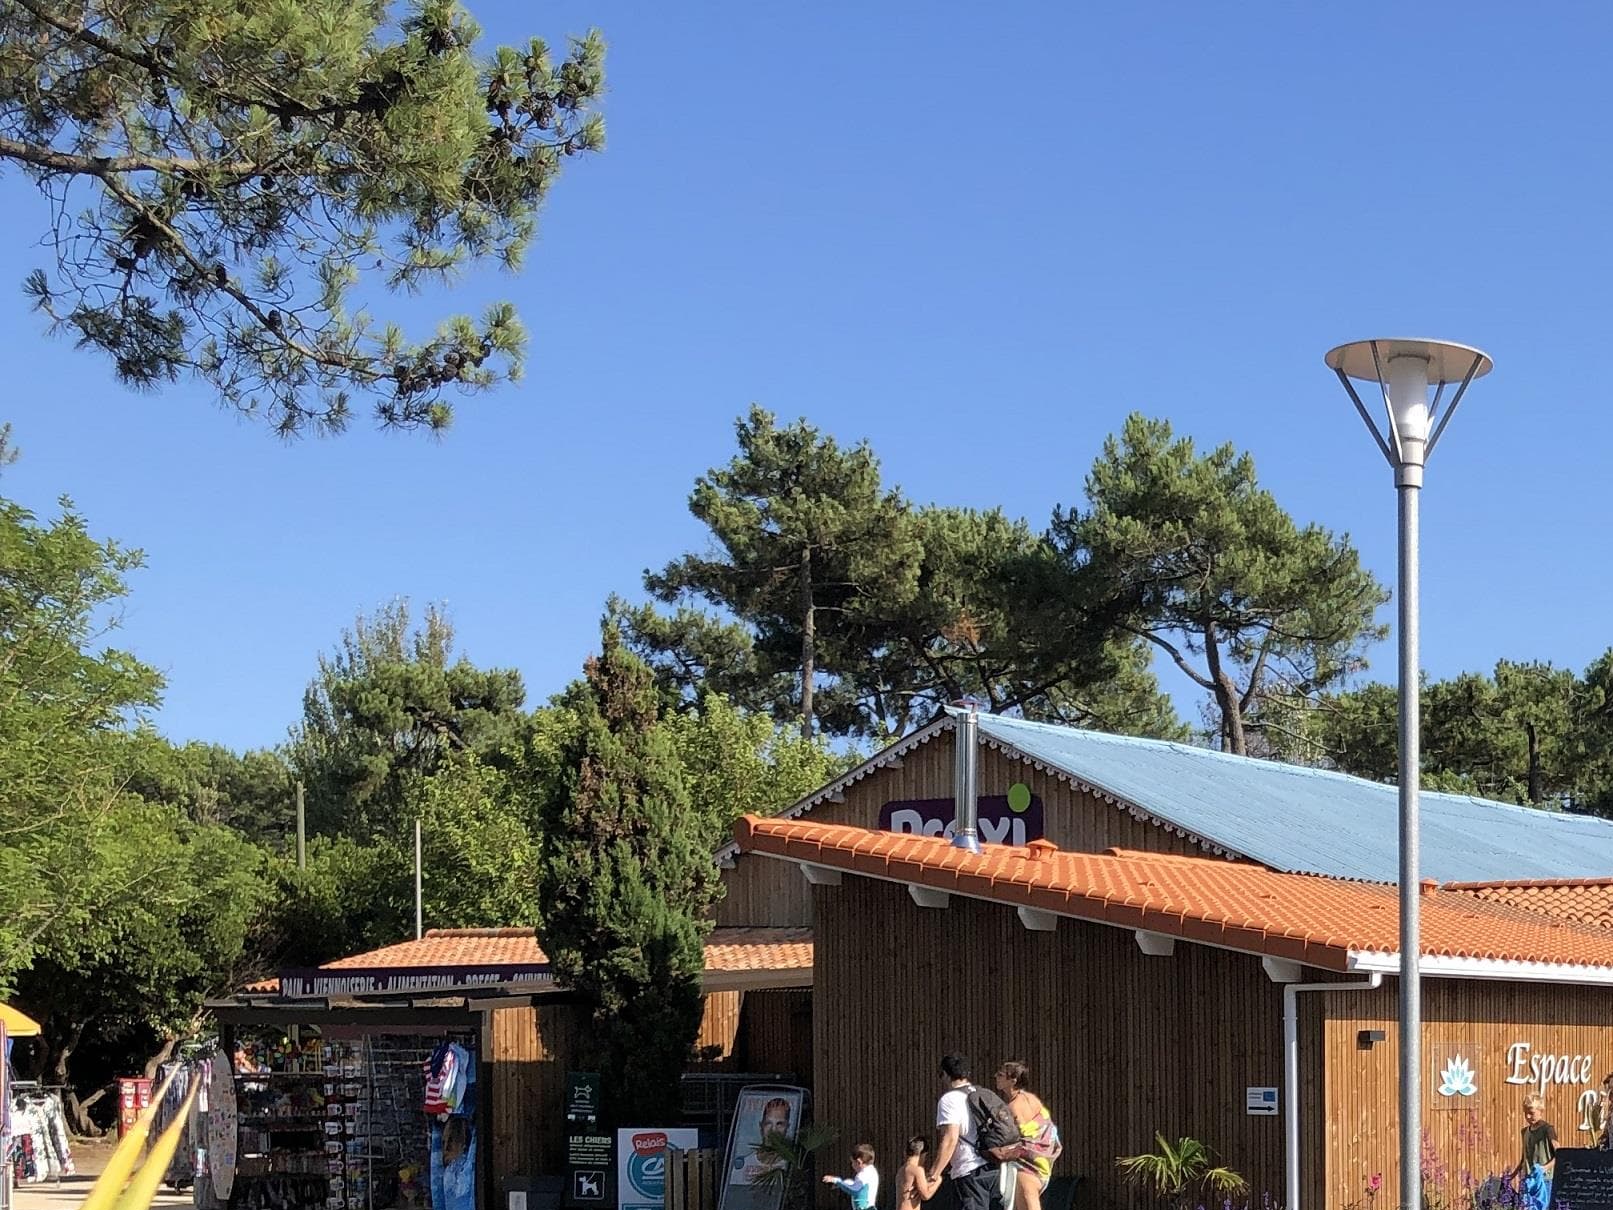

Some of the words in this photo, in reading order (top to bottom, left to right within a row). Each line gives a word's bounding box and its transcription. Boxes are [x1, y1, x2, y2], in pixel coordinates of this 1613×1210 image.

[282, 978, 304, 998] PAIN
[313, 976, 375, 995] VIENNOISERIE
[387, 975, 454, 991] ALIMENTATION
[1505, 1043, 1592, 1097] Espace
[635, 1136, 666, 1150] Relais
